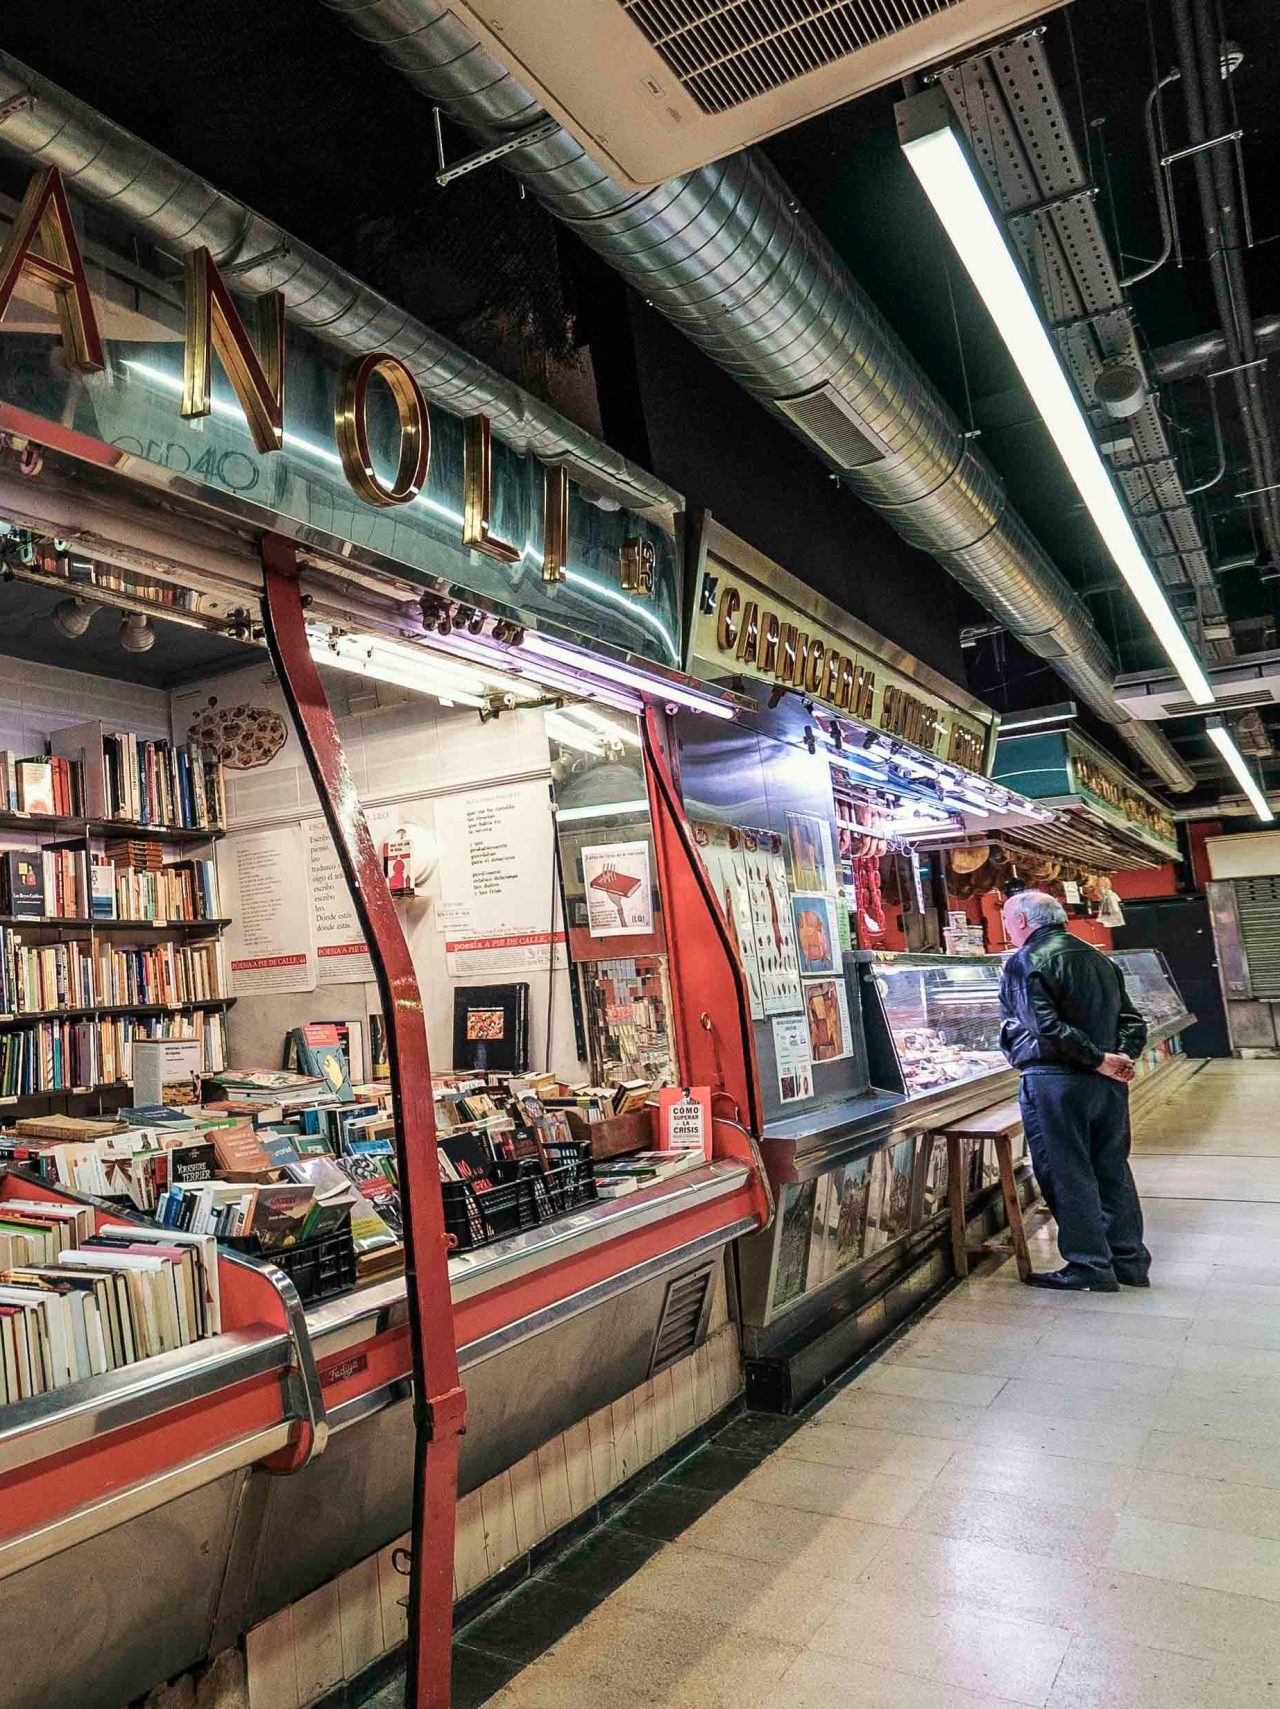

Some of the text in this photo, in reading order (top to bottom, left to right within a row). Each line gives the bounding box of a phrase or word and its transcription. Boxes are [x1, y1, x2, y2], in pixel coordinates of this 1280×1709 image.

[673, 1126, 699, 1134] CRISIS
[176, 1161, 207, 1175] YORKSHIRE
[182, 1169, 211, 1183] TERRIER
